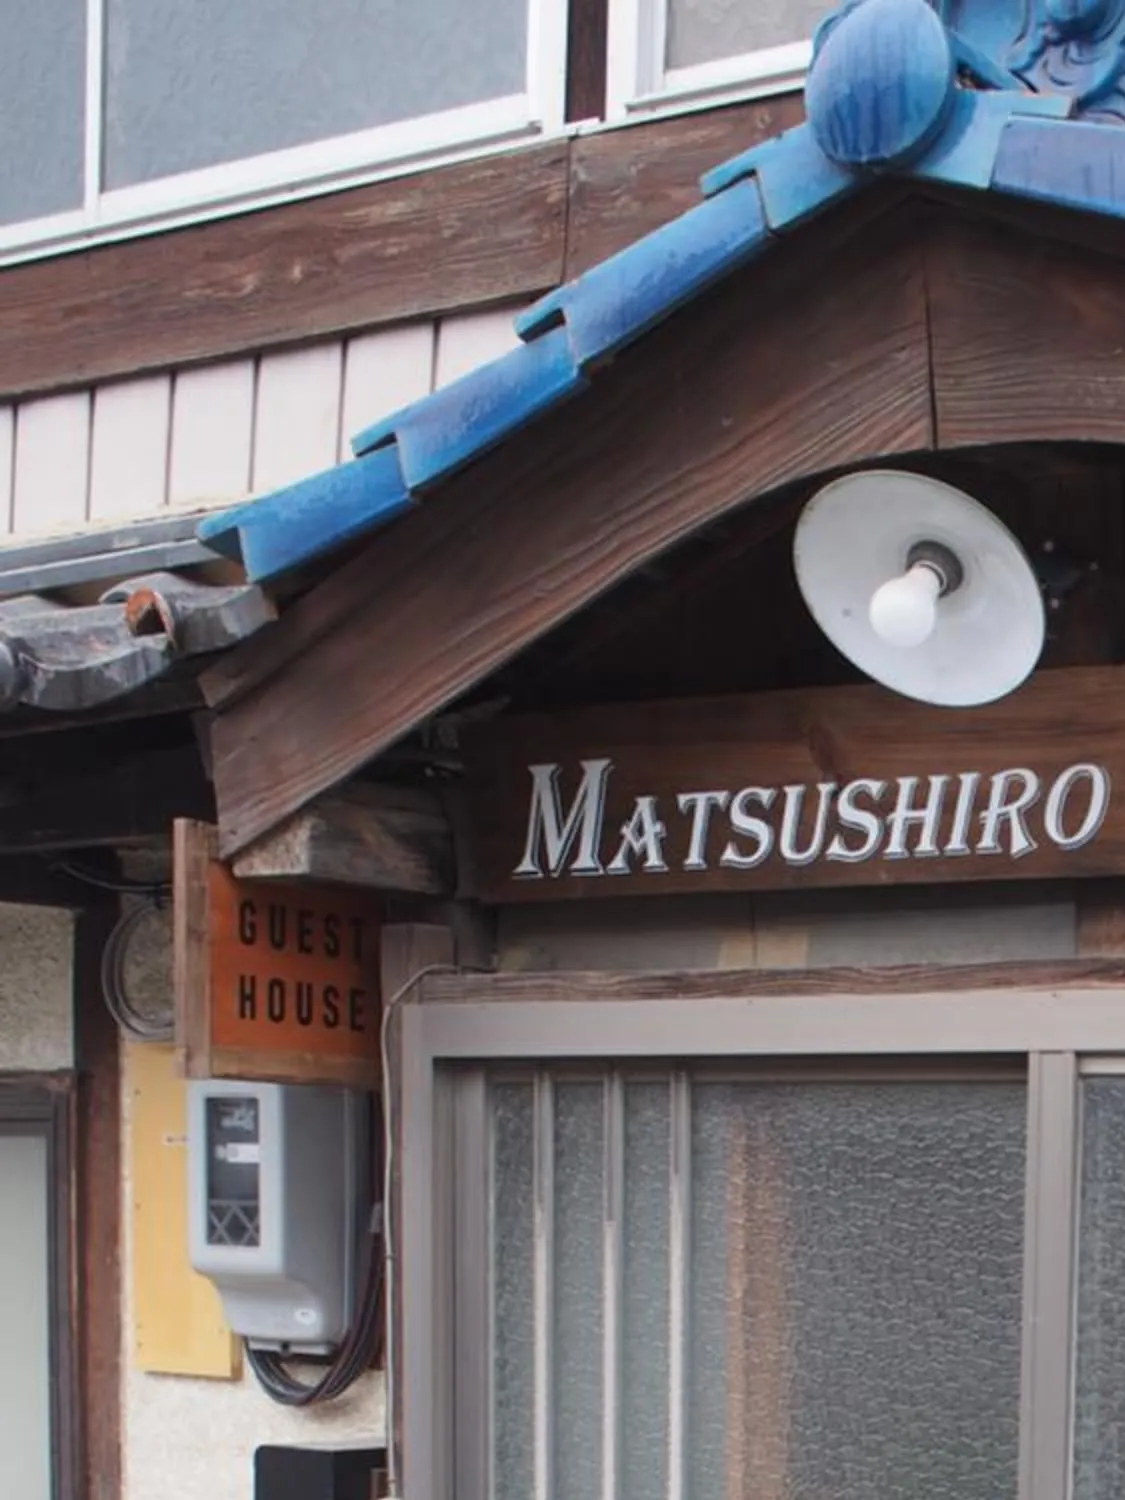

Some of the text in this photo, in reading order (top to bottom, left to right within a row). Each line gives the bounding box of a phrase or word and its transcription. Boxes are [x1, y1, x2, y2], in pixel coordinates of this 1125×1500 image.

[513, 757, 1111, 879] MATSUSHIRO
[239, 900, 367, 962] GUEST
[239, 974, 367, 1032] HOUSE
